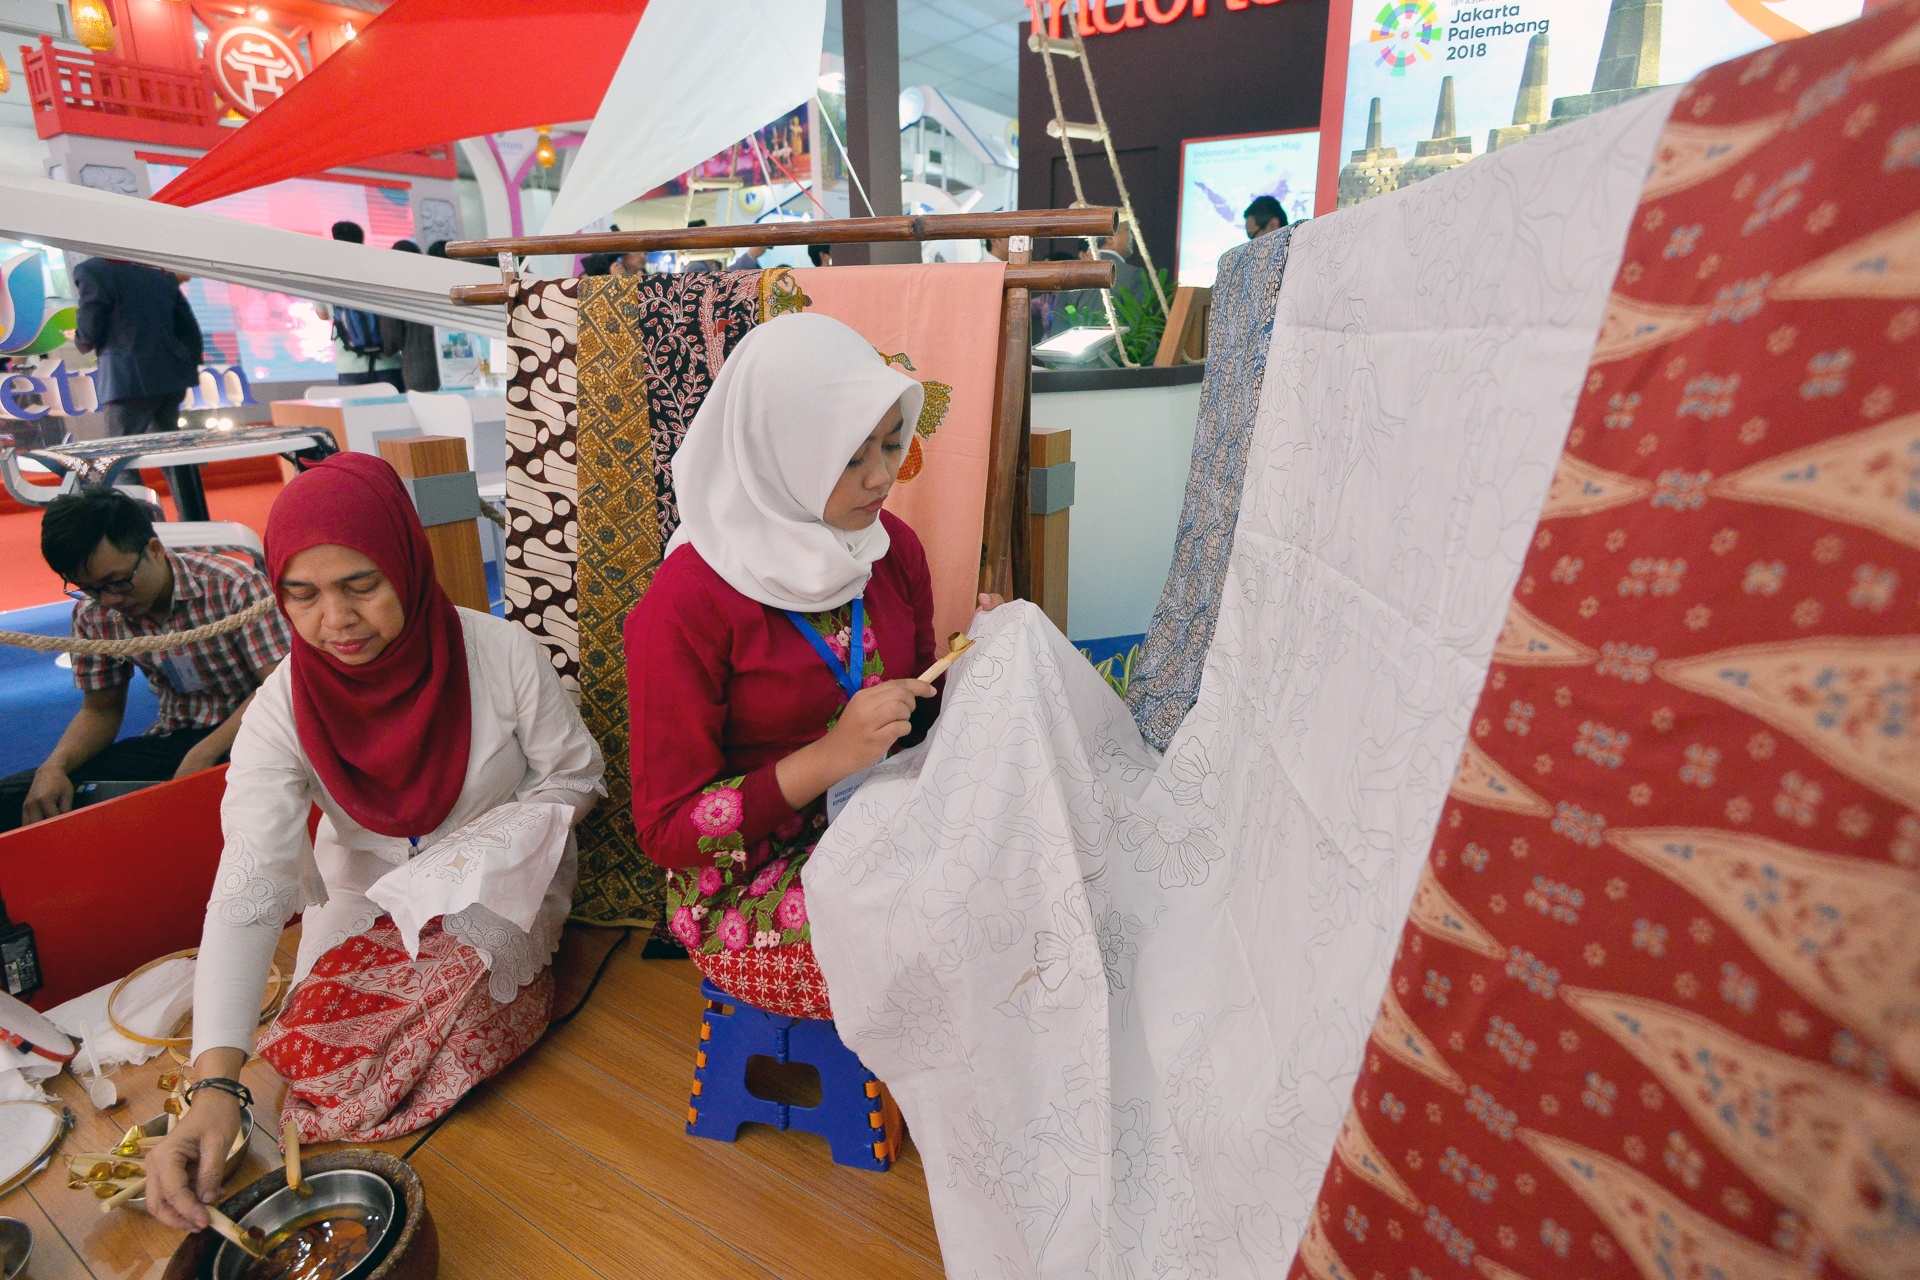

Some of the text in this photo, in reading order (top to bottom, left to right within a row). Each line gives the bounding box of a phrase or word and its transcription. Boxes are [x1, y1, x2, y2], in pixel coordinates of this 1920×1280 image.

[1450, 4, 1520, 24] Jakarta
[1448, 19, 1550, 42] Palembang
[1446, 42, 1487, 61] 2018
